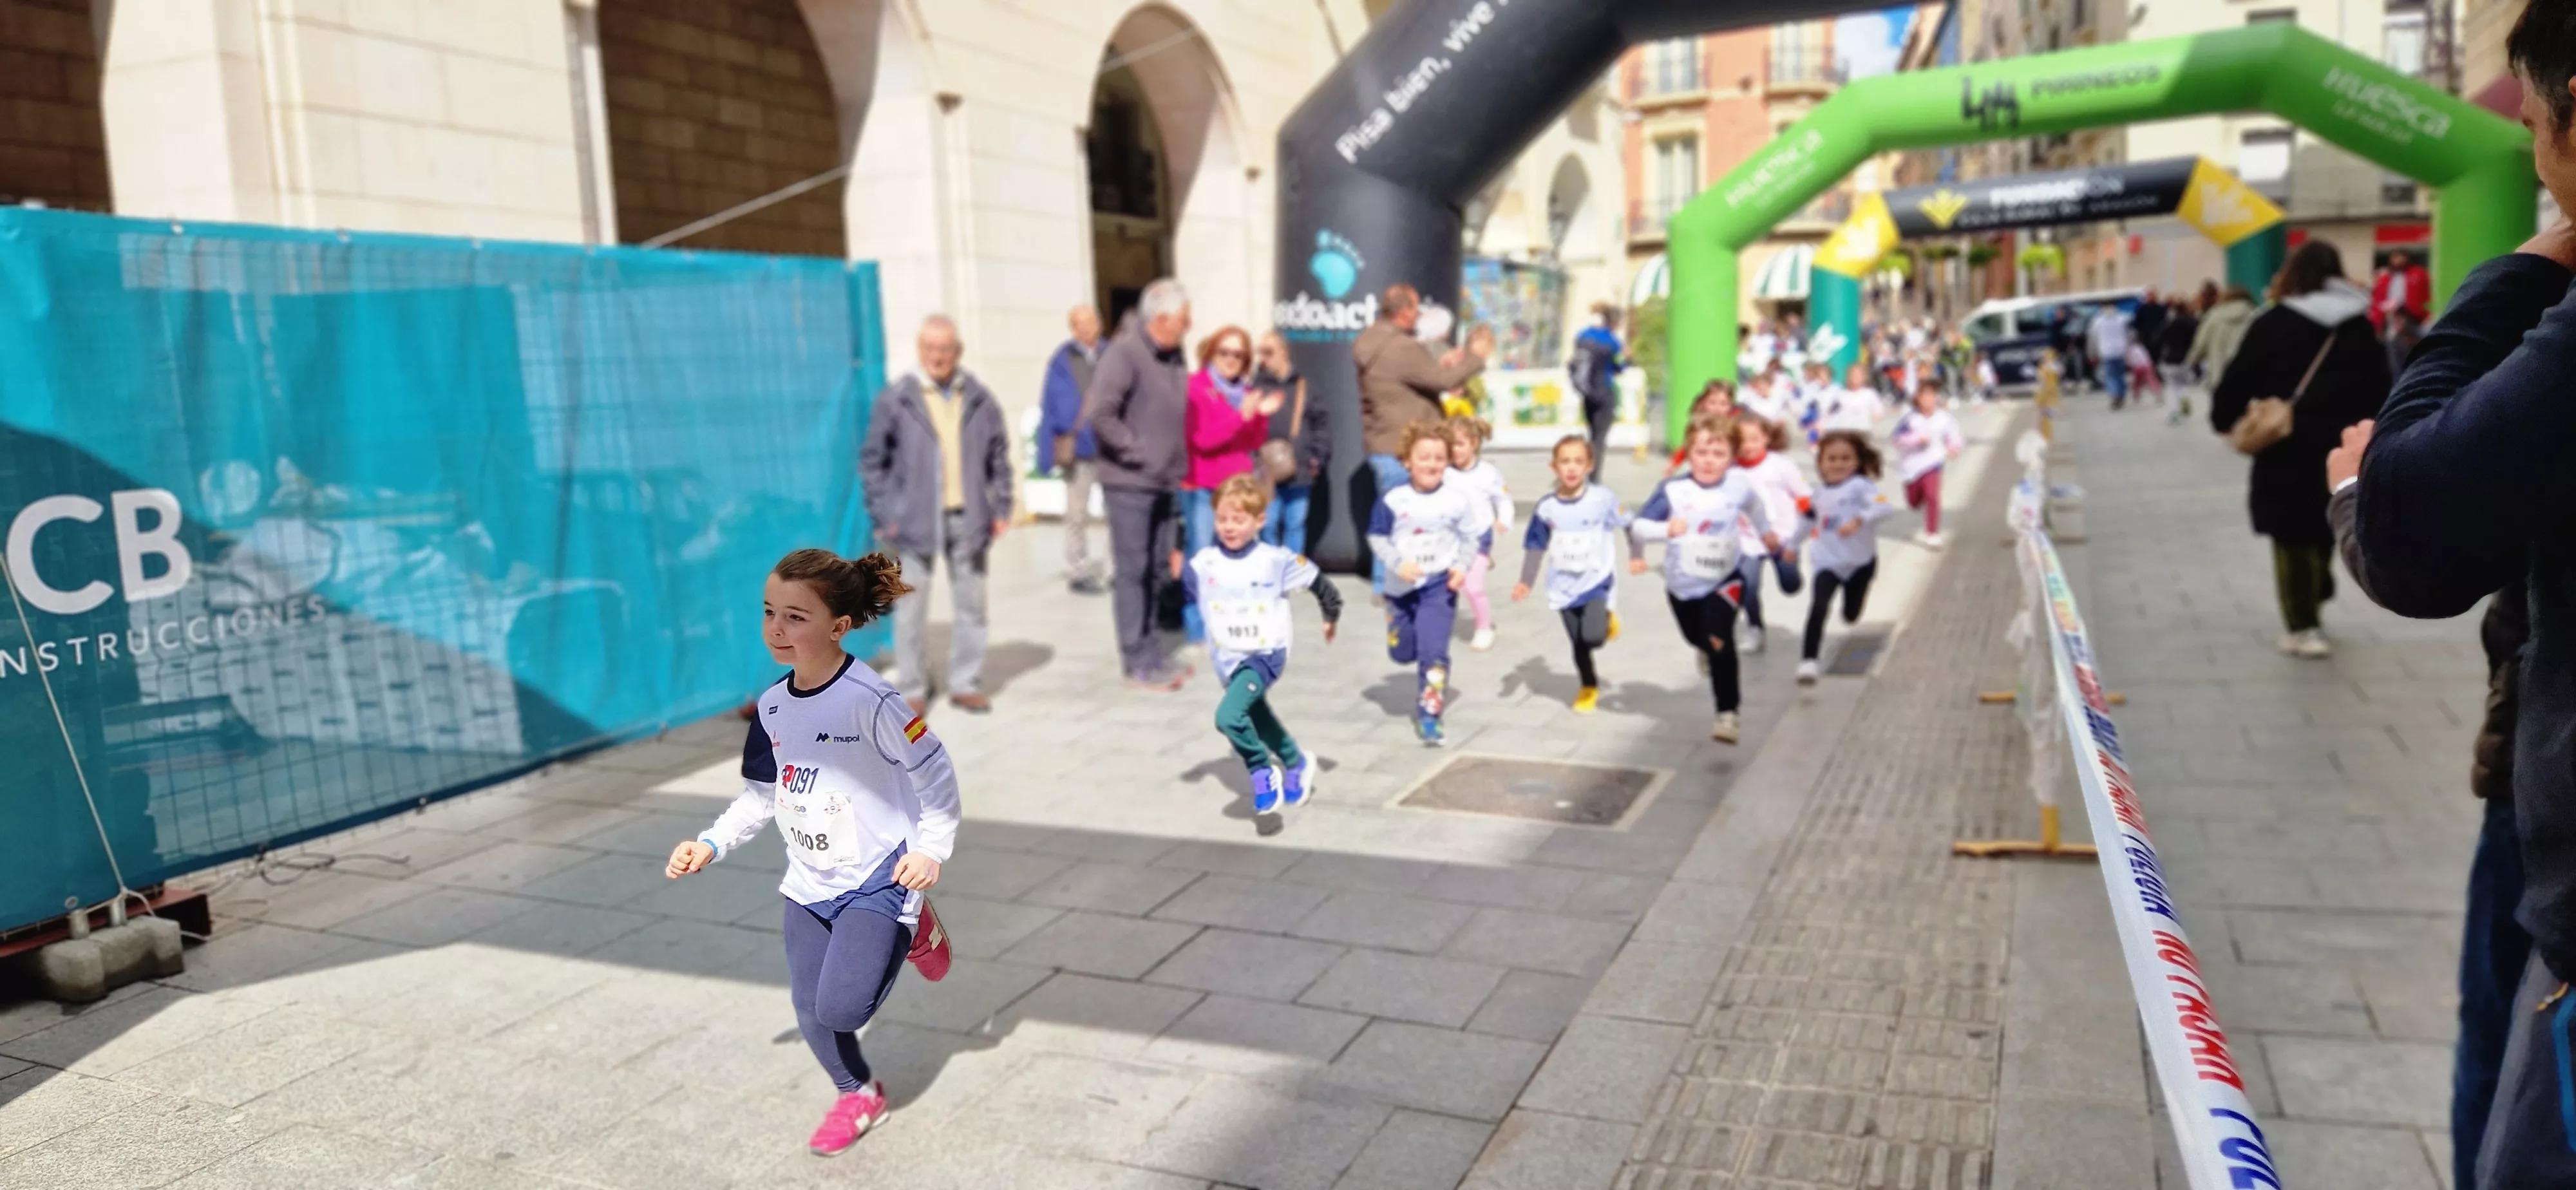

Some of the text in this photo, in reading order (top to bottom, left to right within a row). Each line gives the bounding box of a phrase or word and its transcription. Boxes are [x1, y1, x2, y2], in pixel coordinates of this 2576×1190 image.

[1443, 1, 1495, 53] vive
[6, 487, 193, 615] CB
[833, 735, 860, 744] mupol
[790, 826, 829, 851] 1008
